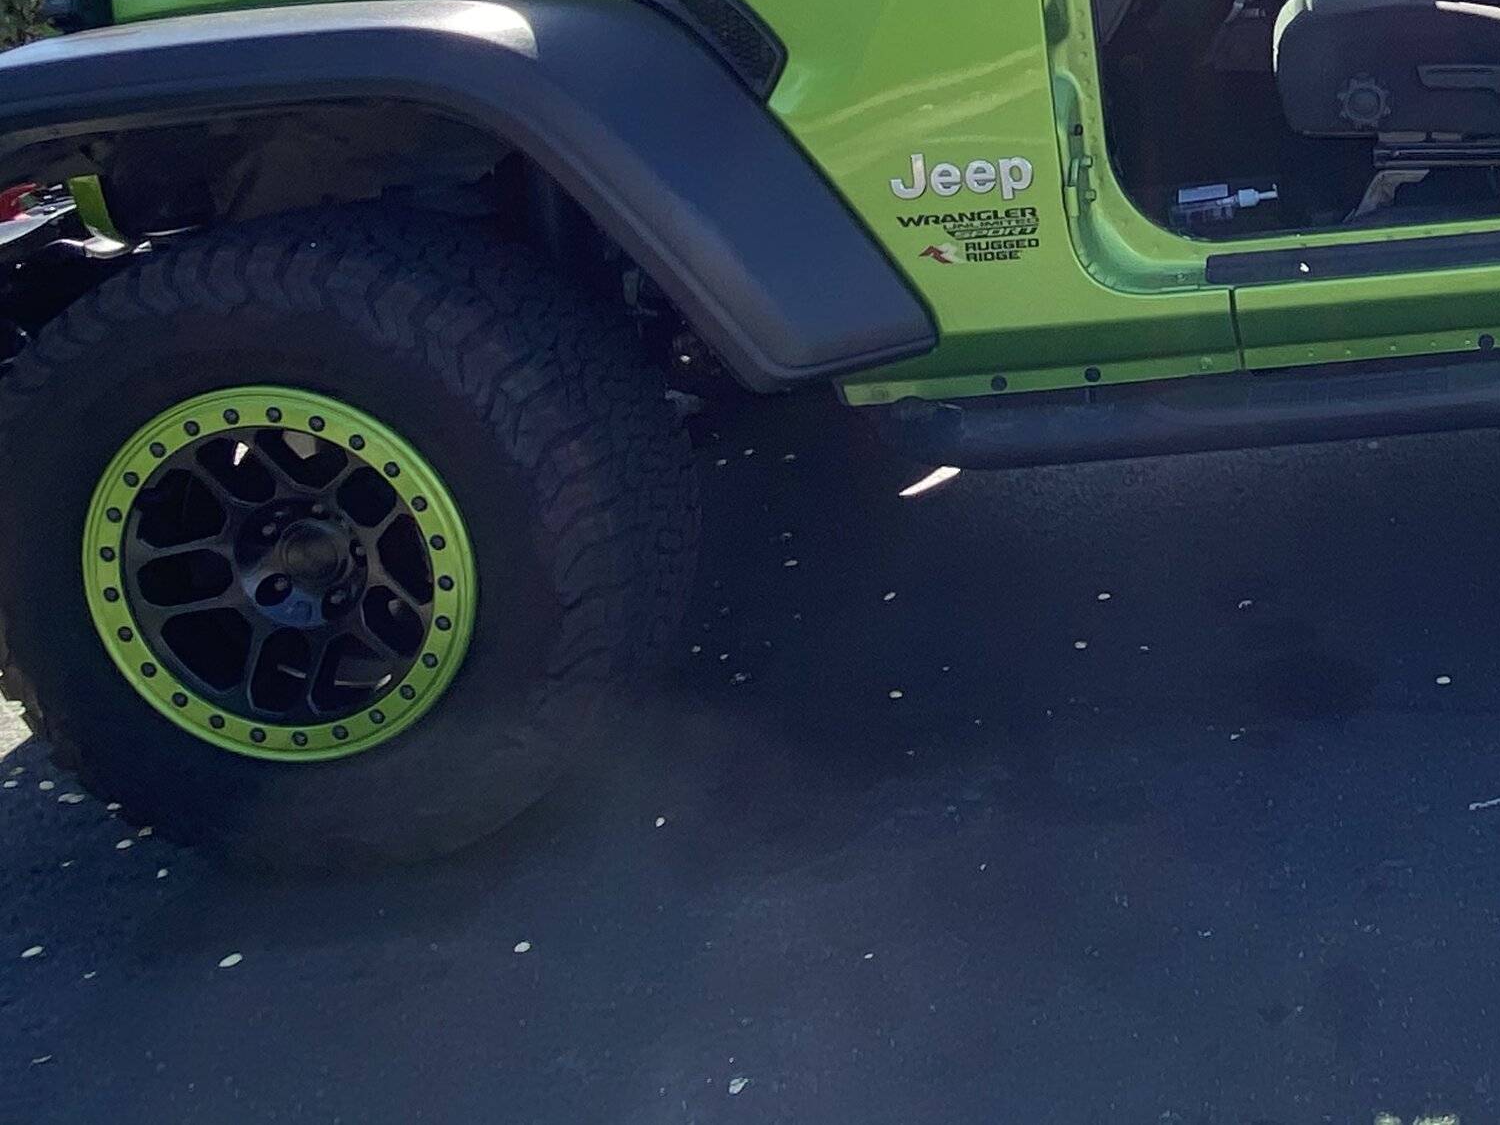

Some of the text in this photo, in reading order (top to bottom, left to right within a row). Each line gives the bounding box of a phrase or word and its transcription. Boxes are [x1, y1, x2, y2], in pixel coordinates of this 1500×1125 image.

[890, 153, 1033, 200] Jeep
[896, 207, 1037, 227] WRANGLER
[965, 238, 1040, 252] RUGGED
[966, 250, 1022, 262] RIDGE
